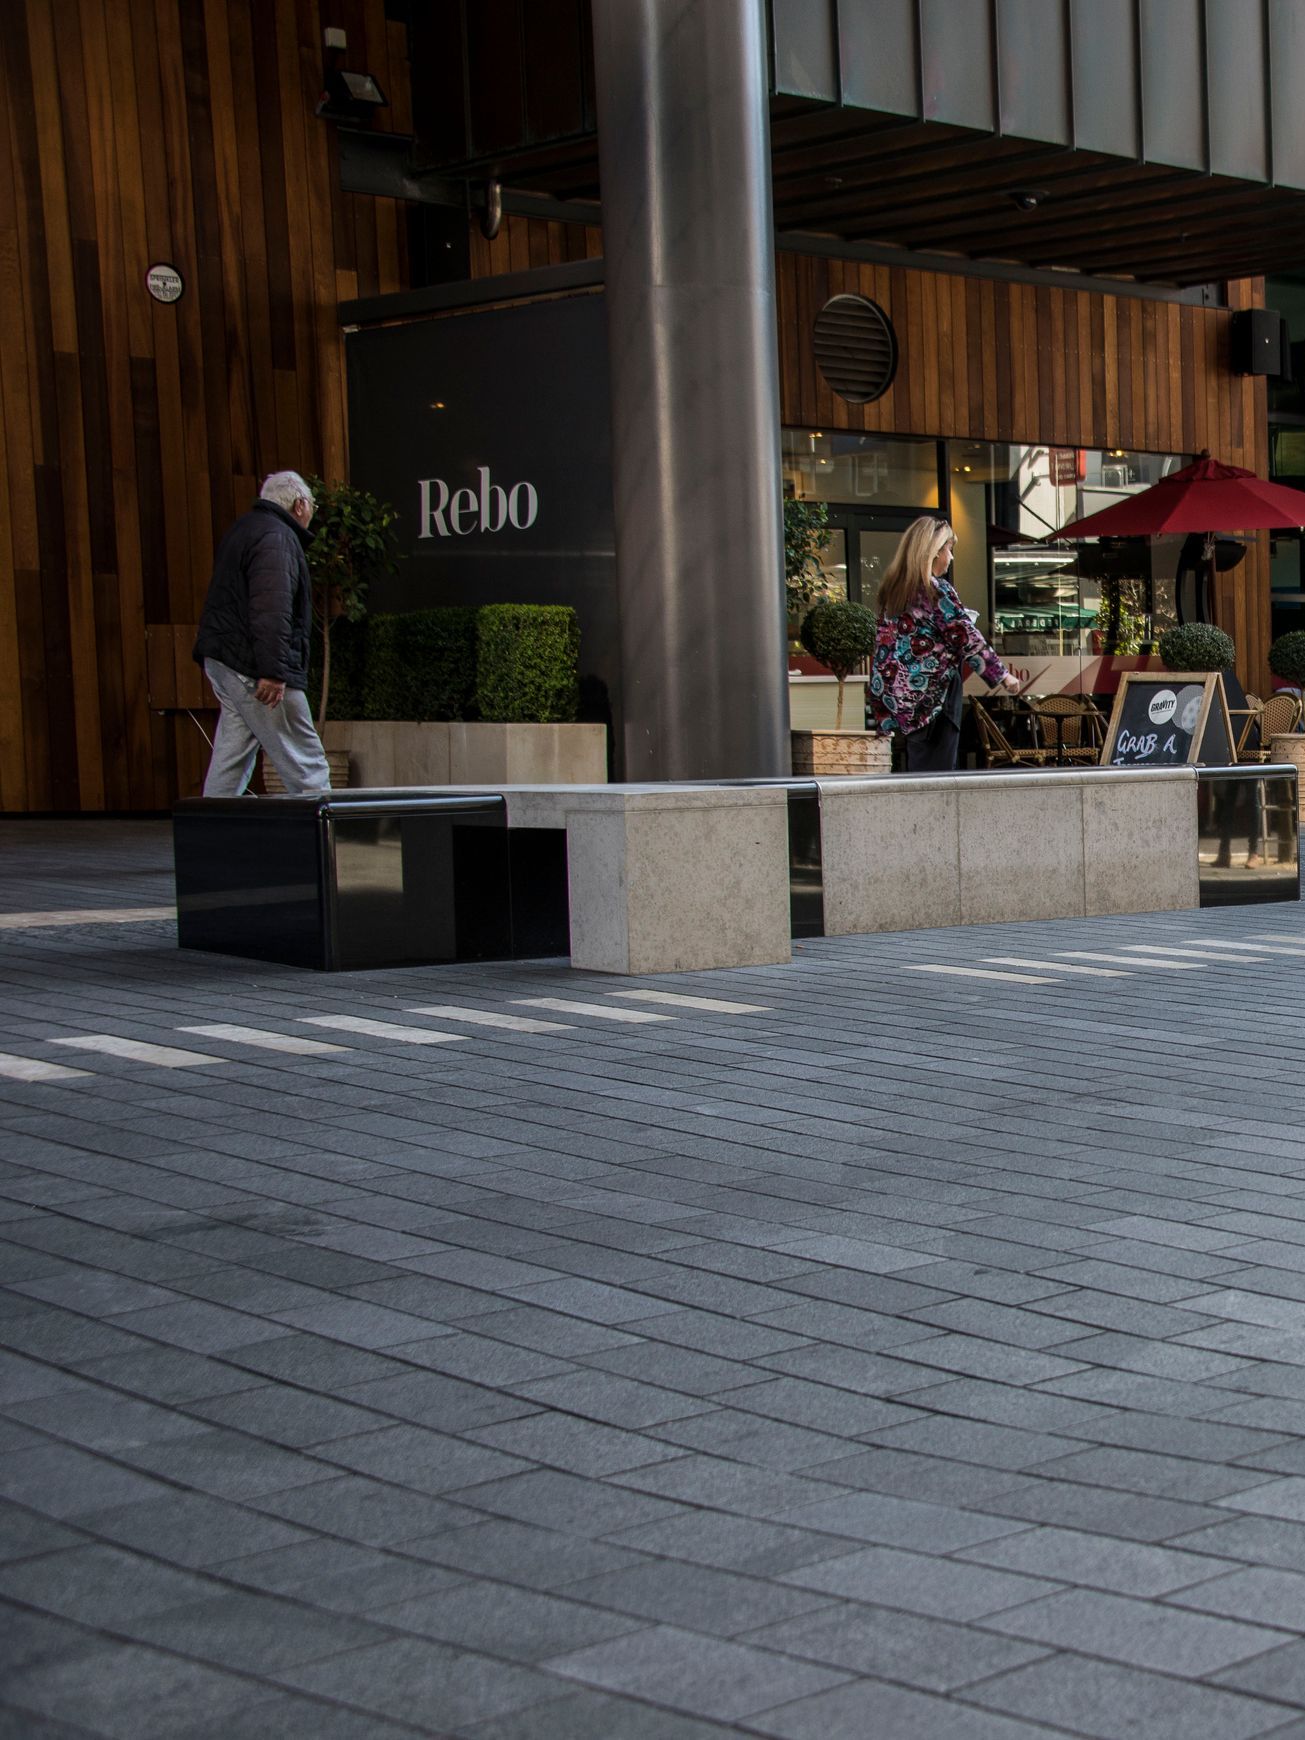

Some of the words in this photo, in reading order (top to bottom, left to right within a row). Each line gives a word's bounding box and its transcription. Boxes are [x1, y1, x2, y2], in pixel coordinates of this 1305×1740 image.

[418, 466, 538, 539] Rebo
[1150, 699, 1176, 713] GRAVITY
[1117, 729, 1158, 759] GRAB
[1163, 733, 1177, 754] A
